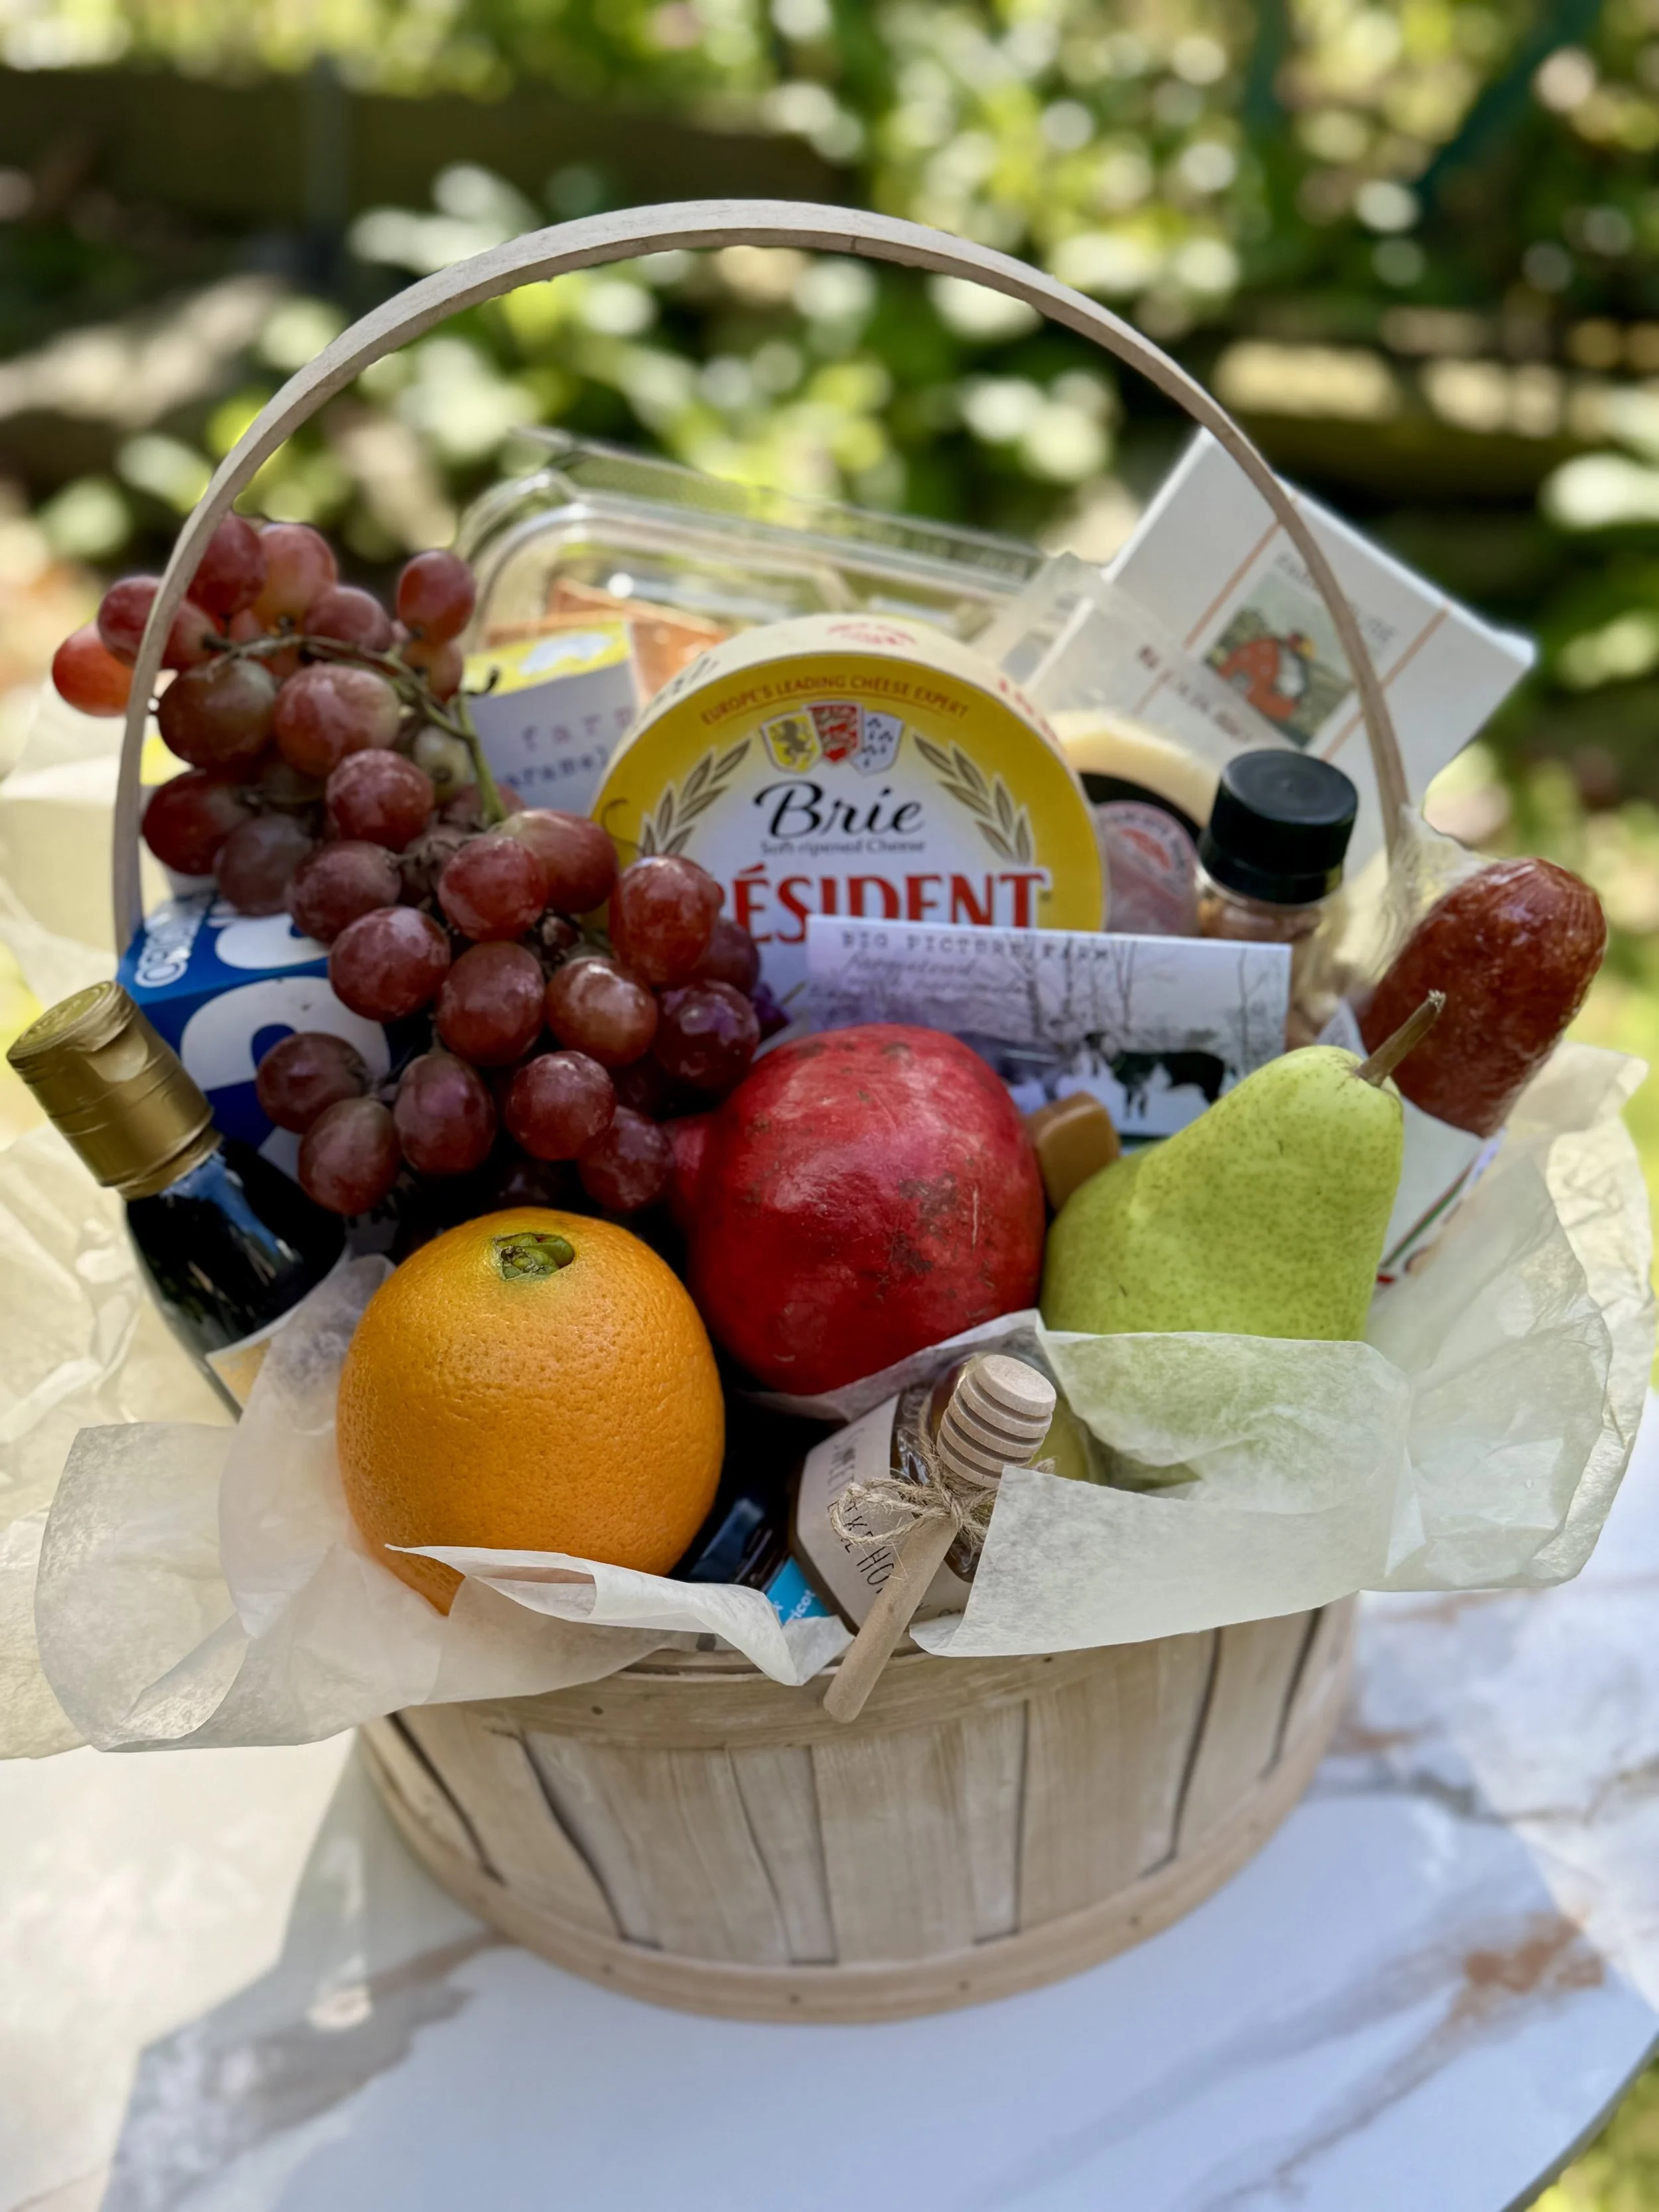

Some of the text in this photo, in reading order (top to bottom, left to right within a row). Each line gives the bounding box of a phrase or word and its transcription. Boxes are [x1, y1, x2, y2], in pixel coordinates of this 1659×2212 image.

[701, 684, 772, 726] EUROPE'S
[776, 675, 847, 696] LEADING
[850, 675, 909, 696] CHEESE
[913, 686, 970, 718] EXPERT
[752, 779, 925, 839] Brie
[718, 862, 1045, 944] ÉSIDENT
[841, 930, 889, 950] BIG
[906, 933, 1027, 958] PICTURE
[786, 1589, 817, 1621] icot
